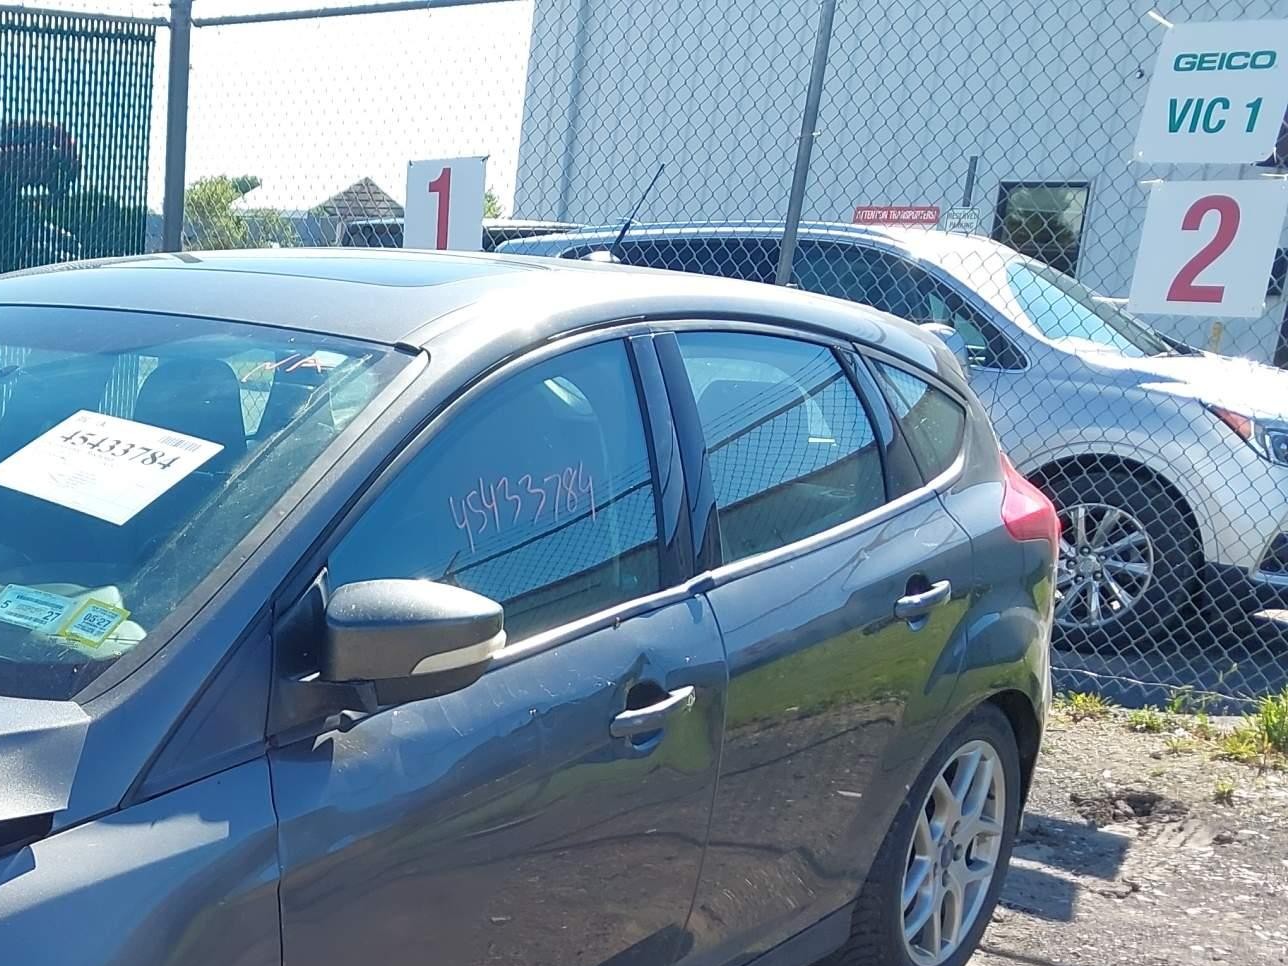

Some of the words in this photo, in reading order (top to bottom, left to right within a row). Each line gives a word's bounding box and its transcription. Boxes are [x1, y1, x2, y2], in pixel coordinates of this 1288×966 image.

[1173, 50, 1277, 71] GEICO
[1168, 97, 1230, 133] VIC
[1245, 97, 1263, 133] 1
[428, 167, 452, 251] 1
[1166, 194, 1241, 303] 2
[61, 430, 181, 470] 45433784
[449, 459, 596, 554] 45433784
[43, 610, 62, 623] 27
